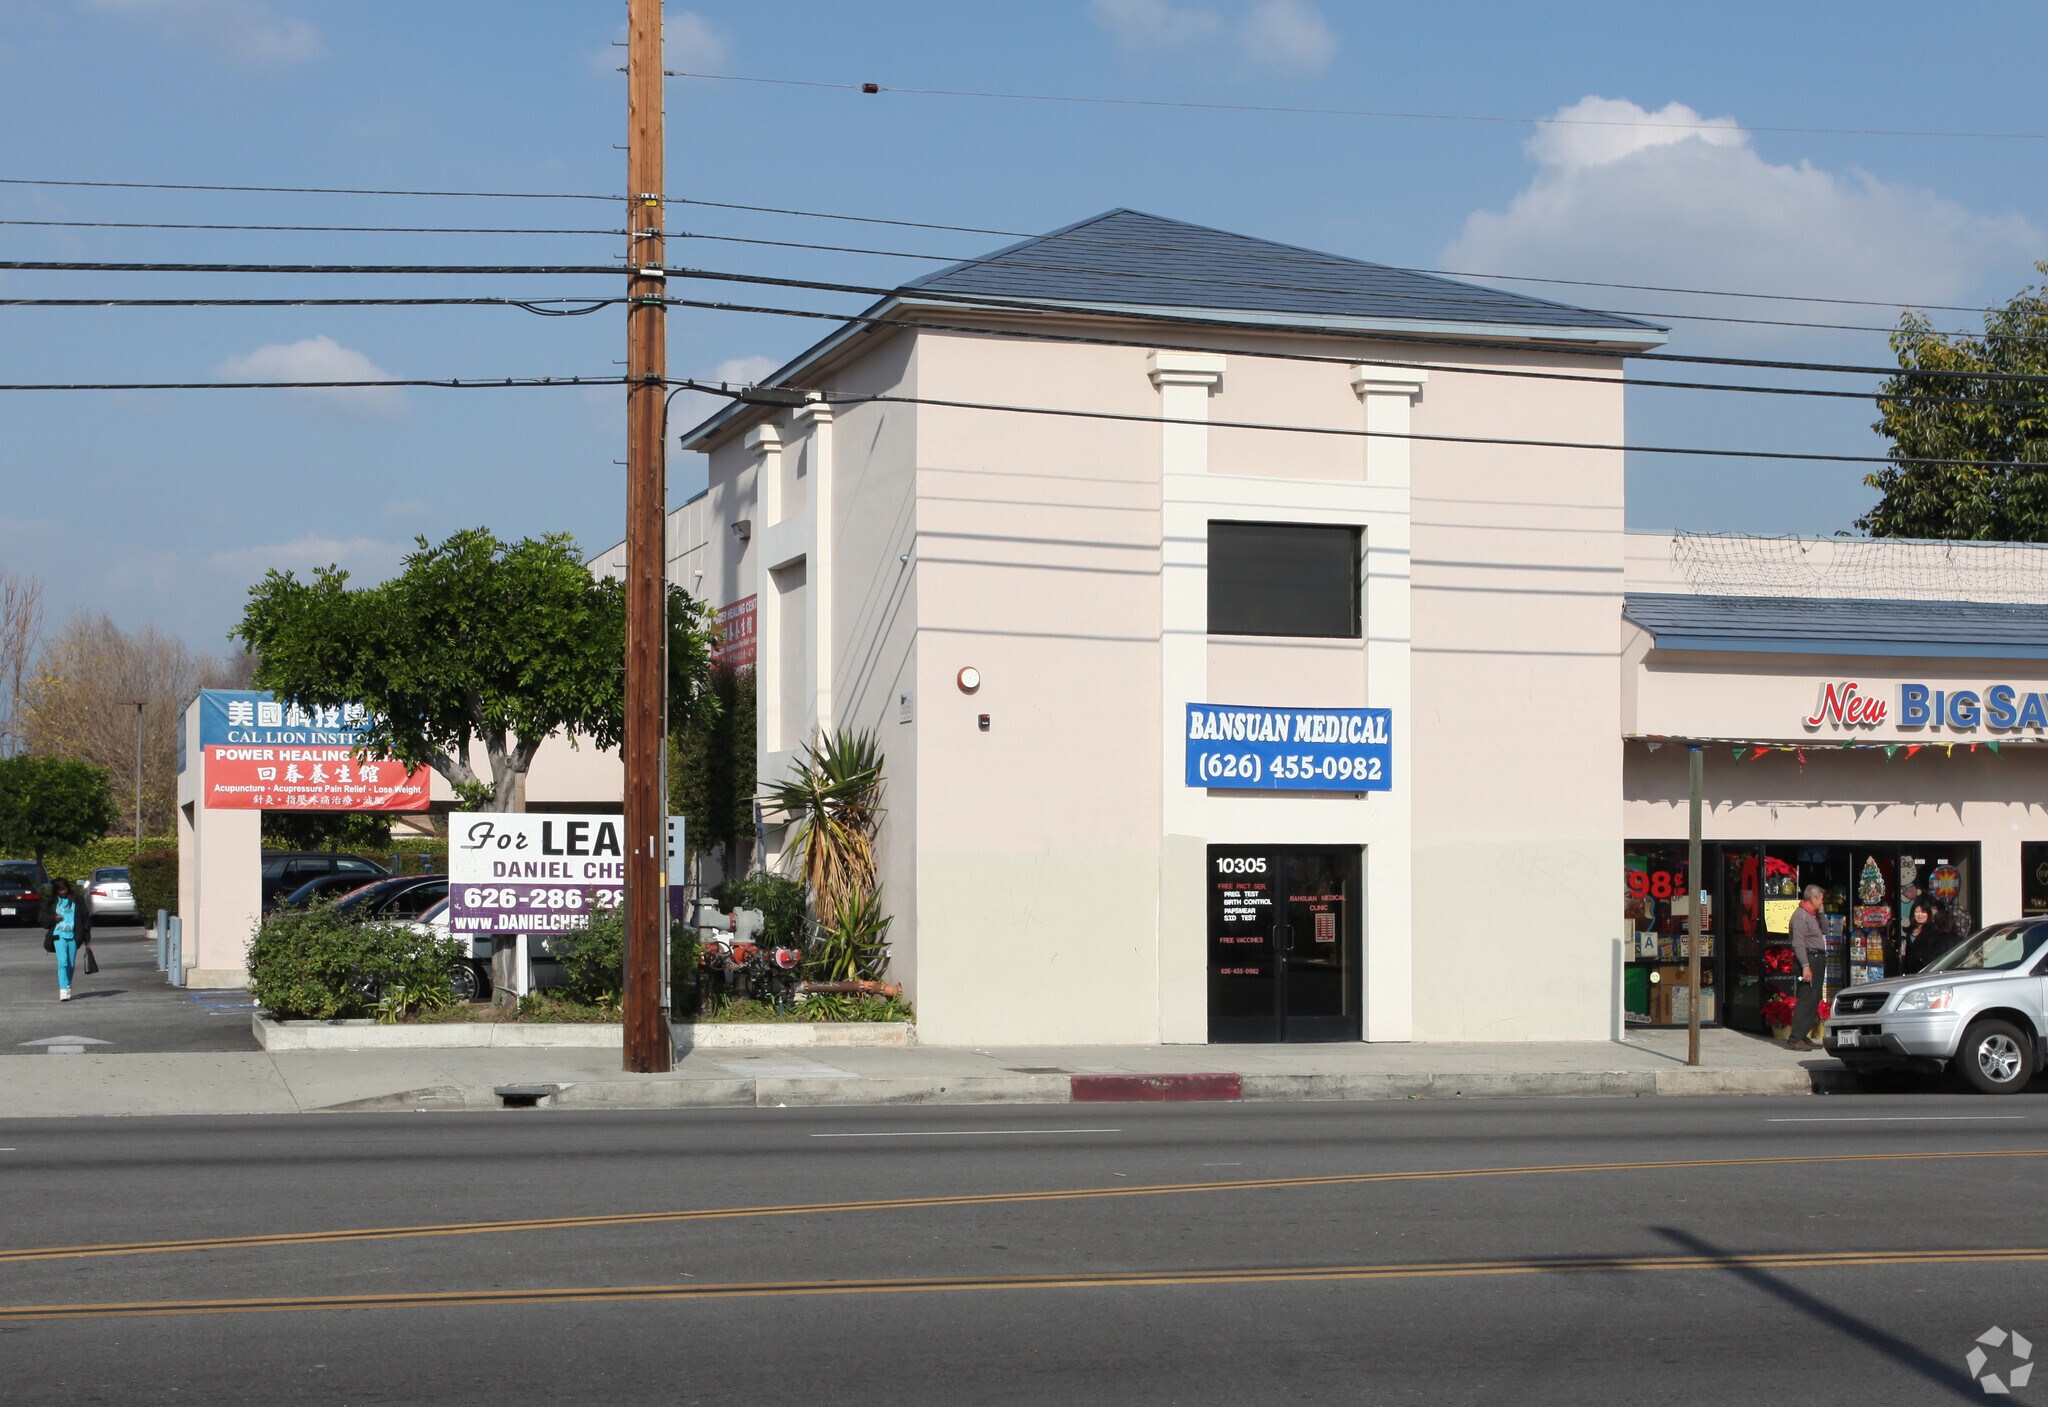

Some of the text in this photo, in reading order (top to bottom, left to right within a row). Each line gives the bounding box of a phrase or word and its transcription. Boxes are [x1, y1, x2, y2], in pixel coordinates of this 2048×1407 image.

[1807, 682, 1888, 727] New
[1989, 684, 2048, 728] SA
[228, 700, 394, 729] 美國科技學
[1189, 711, 1388, 744] BANSUAN MEDICAL
[227, 731, 261, 744] CAL
[266, 732, 306, 744] LION
[216, 749, 274, 761] POWER
[279, 749, 351, 762] HEALING
[257, 763, 380, 783] 回春養生館
[1199, 753, 1382, 782] (626) 455-0982
[214, 783, 421, 794] Acupuncture Acupressure Pain Relief Lose Weight
[252, 794, 275, 805] 針灸
[460, 821, 529, 850] For
[493, 861, 624, 879] DANIEL CHE
[1216, 858, 1267, 873] 10305
[464, 888, 624, 909] 626-286-28
[1765, 901, 1796, 912] SPECIA
[1644, 936, 1654, 949] A
